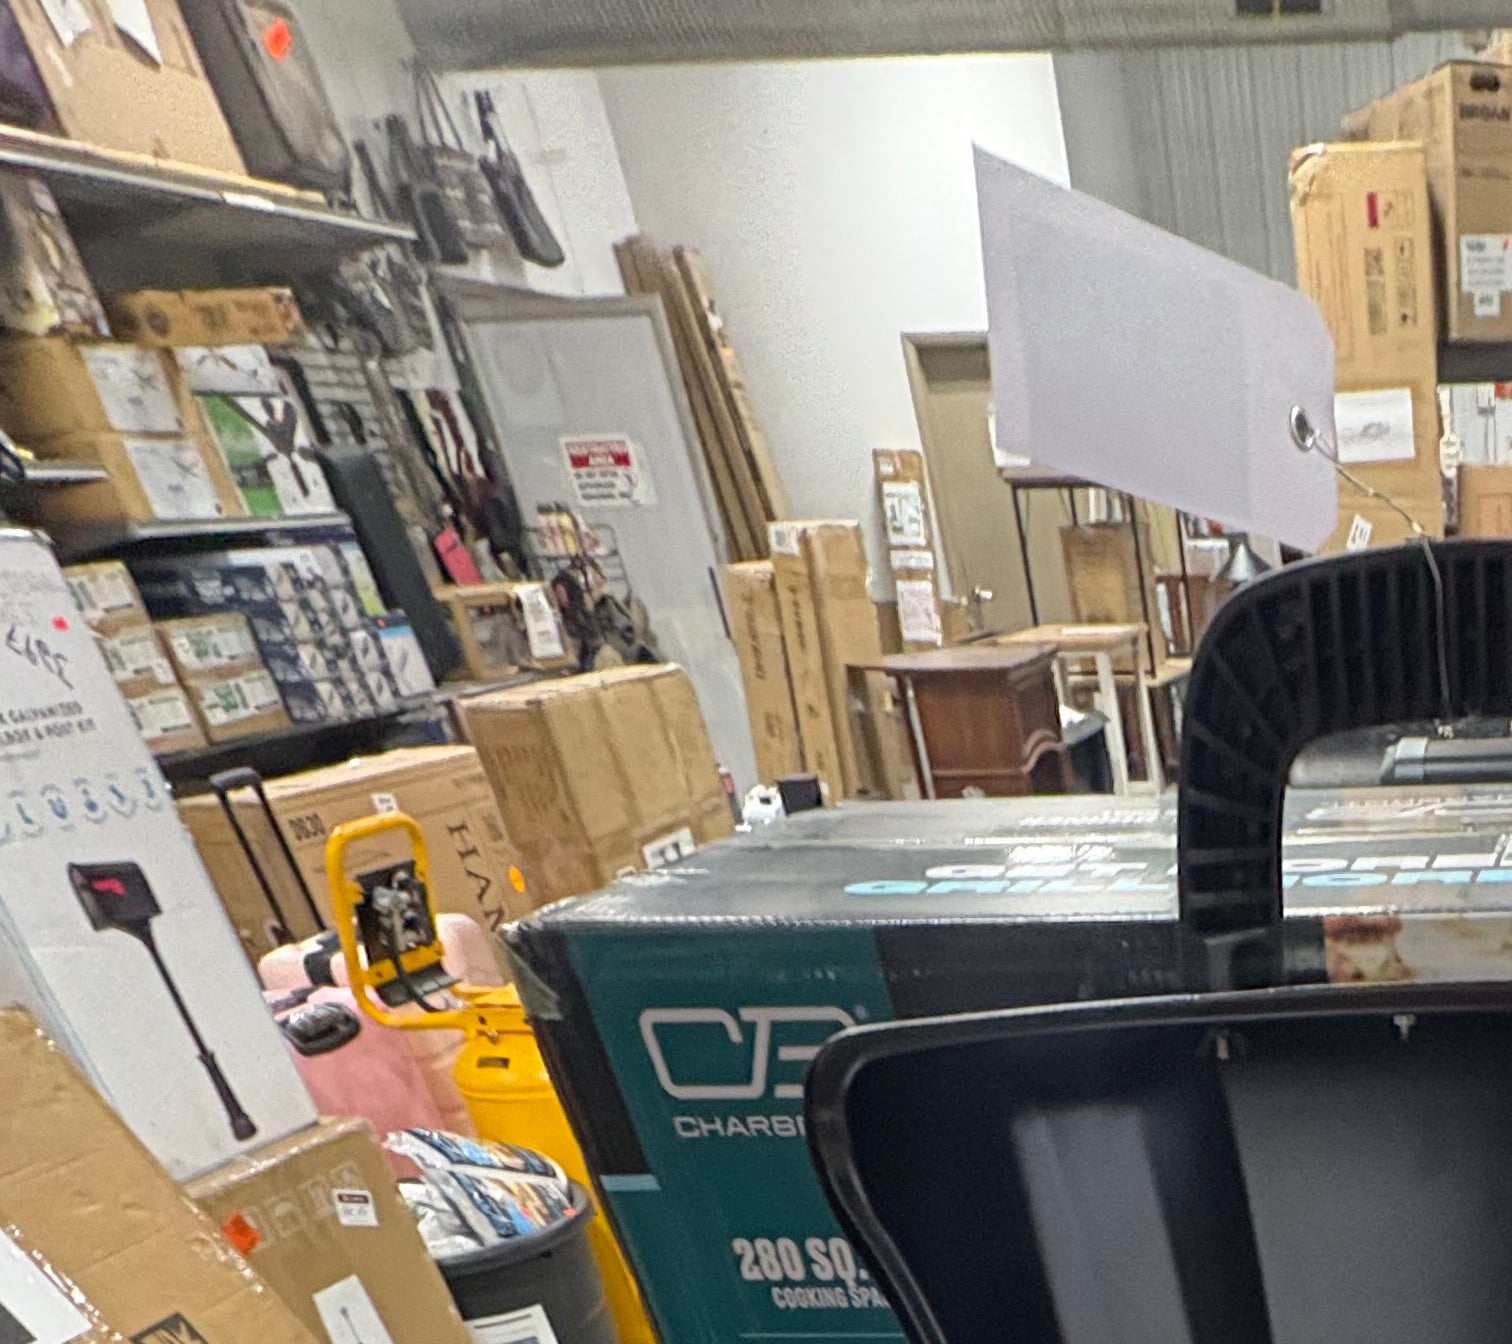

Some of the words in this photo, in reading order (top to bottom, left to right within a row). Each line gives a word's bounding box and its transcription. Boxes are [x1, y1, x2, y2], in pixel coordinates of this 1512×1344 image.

[673, 1114, 807, 1137] CHARB
[732, 1236, 807, 1281] 280
[771, 1286, 850, 1310] COOKING
[849, 1286, 893, 1309] SPA
